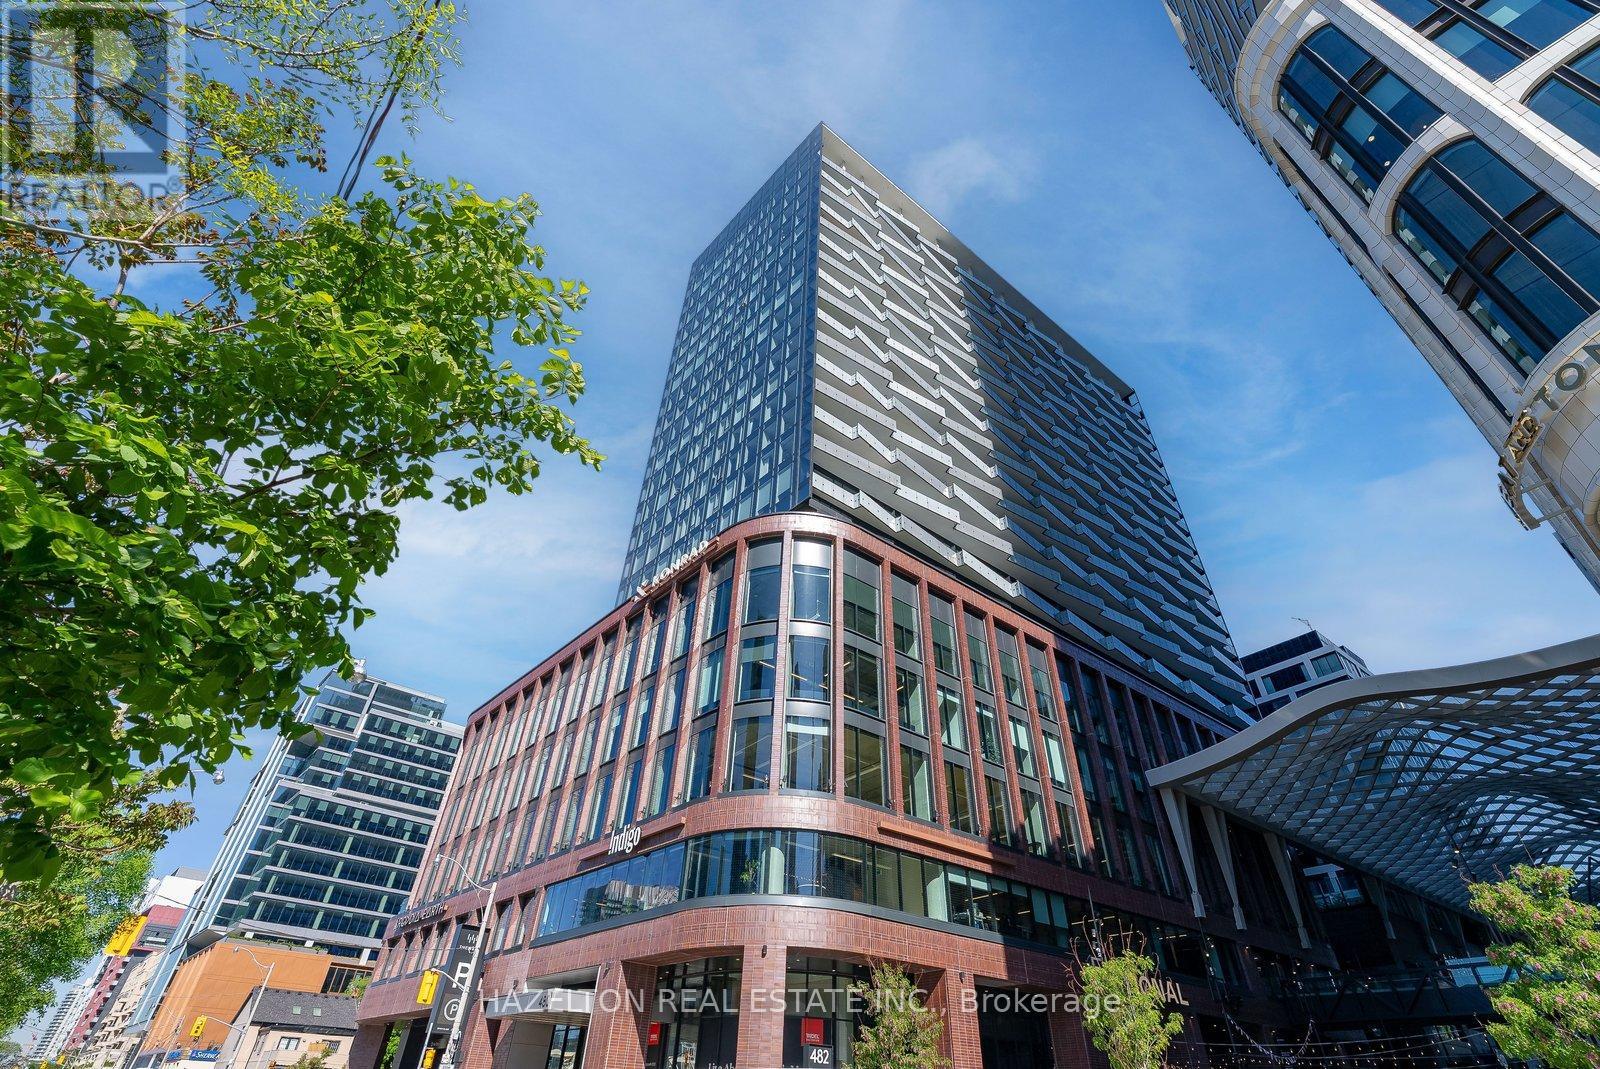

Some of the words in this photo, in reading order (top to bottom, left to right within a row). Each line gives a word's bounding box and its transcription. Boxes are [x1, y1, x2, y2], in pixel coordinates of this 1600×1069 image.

[608, 824, 641, 855] Indigo
[449, 1003, 459, 1015] P
[810, 1048, 830, 1065] 482
